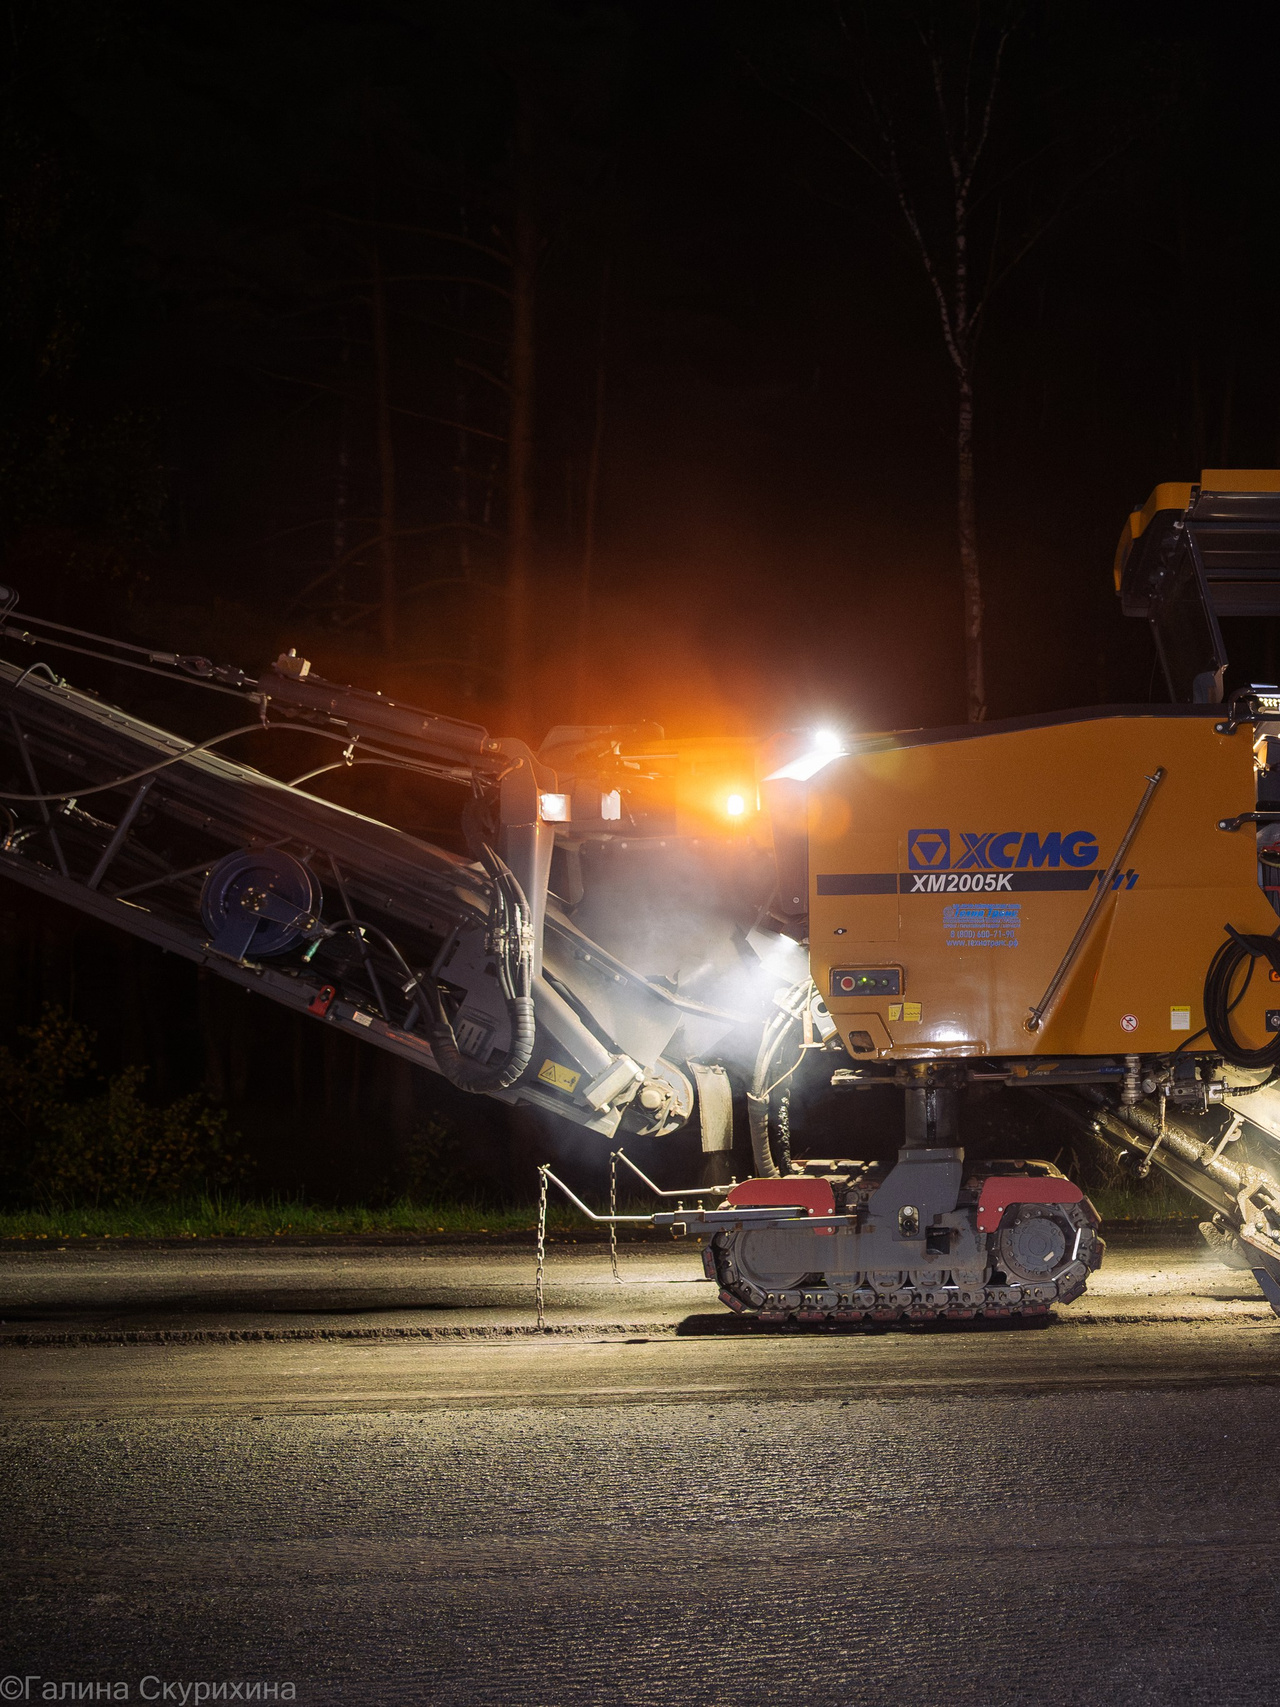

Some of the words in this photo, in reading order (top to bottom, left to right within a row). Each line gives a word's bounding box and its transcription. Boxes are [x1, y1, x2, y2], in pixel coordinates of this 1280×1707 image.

[951, 831, 1099, 869] XCMG
[910, 873, 1014, 893] XM2005K
[950, 930, 956, 938] 8
[957, 930, 976, 939] (800)
[977, 930, 1015, 938] 600-71-90
